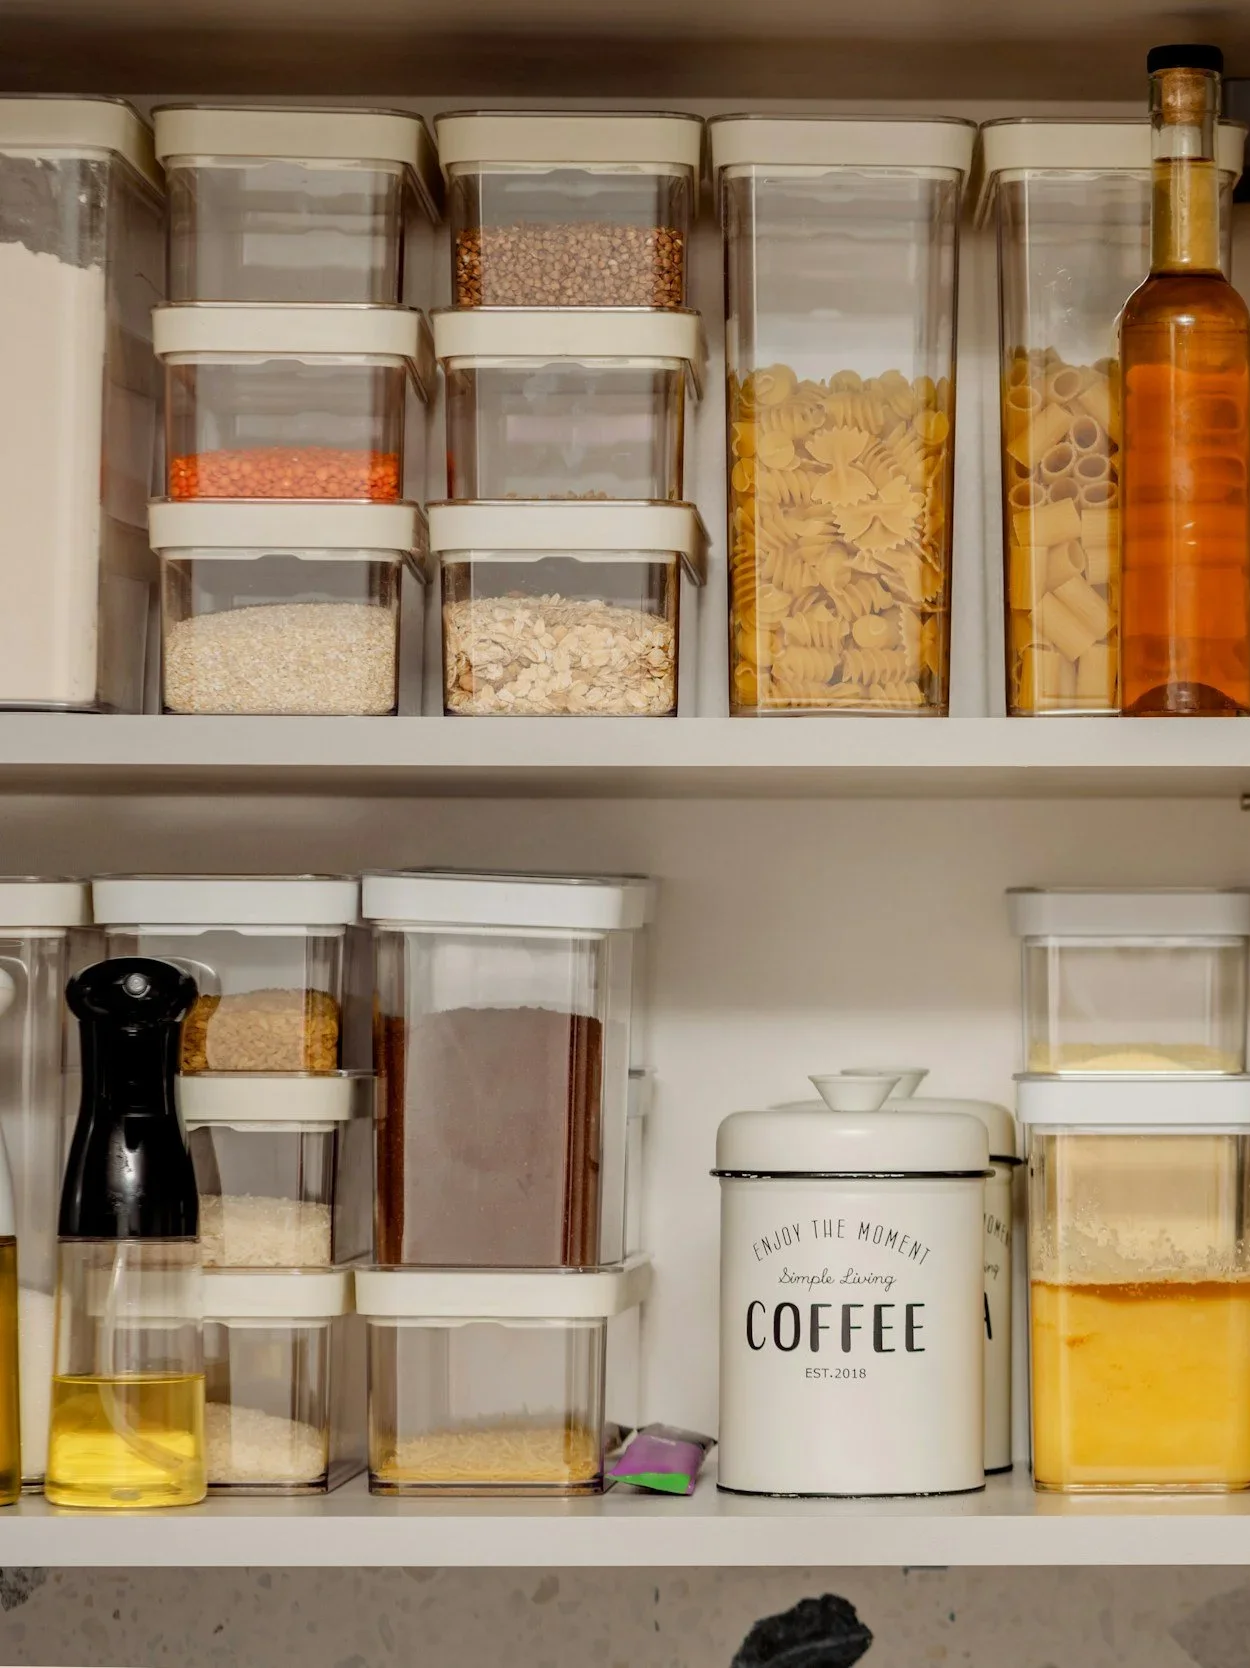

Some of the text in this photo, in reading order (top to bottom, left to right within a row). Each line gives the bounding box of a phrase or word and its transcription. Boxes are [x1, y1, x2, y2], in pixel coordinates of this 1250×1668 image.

[752, 1219, 931, 1265] ENJOY THE MOMENT
[778, 1266, 897, 1292] Simple Living
[746, 1300, 926, 1353] COFFEE
[805, 1367, 867, 1379] EST.2018
